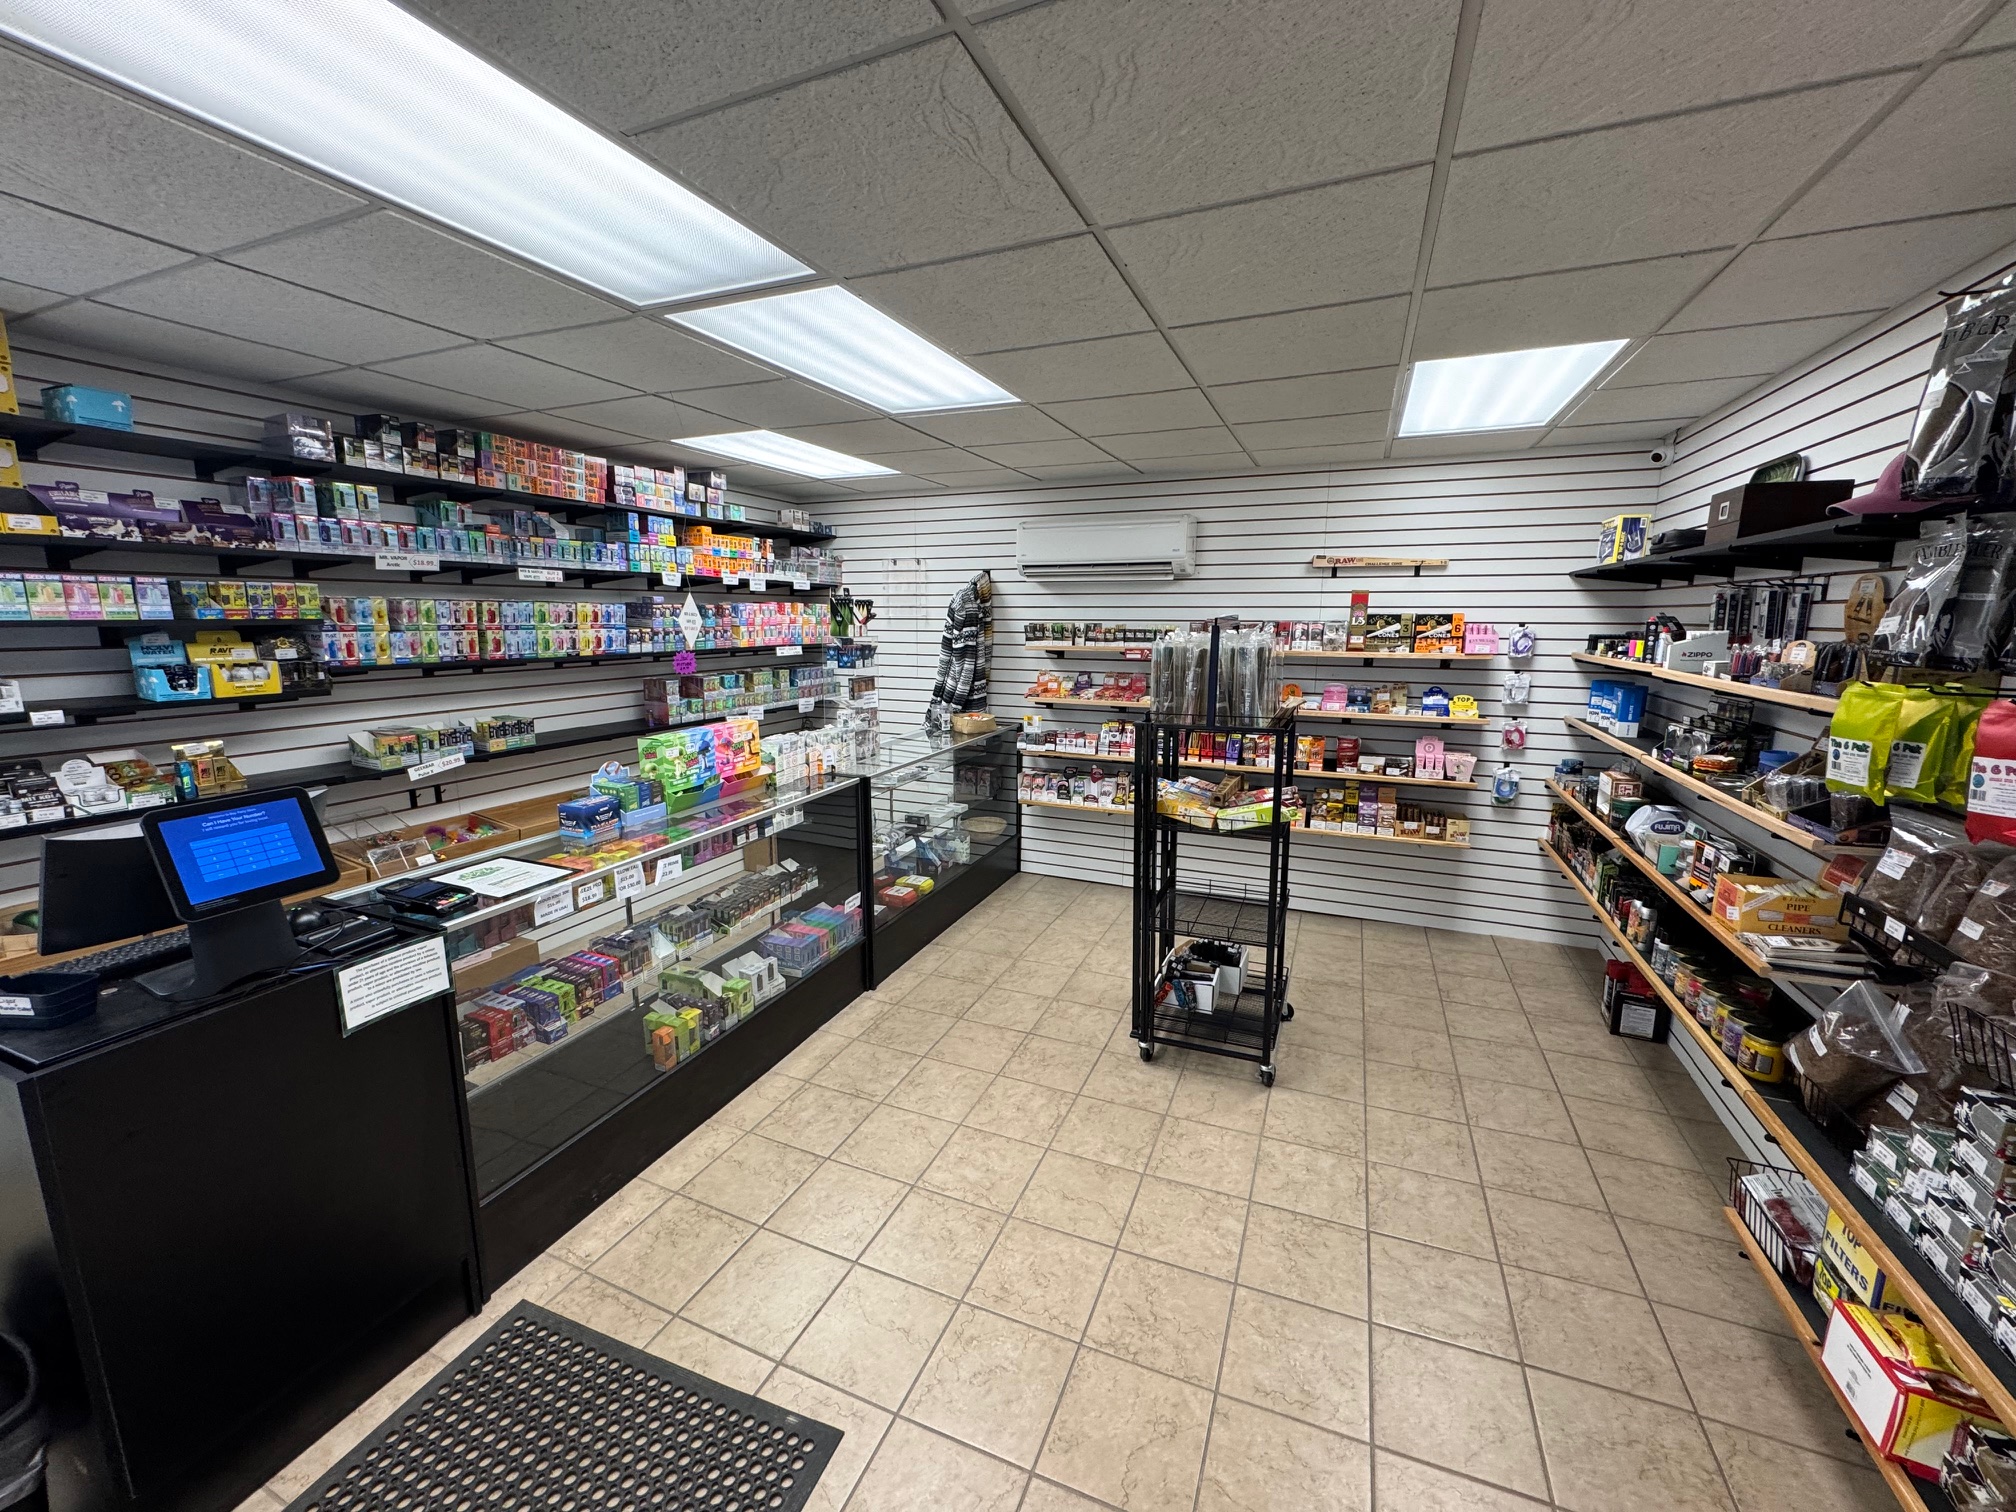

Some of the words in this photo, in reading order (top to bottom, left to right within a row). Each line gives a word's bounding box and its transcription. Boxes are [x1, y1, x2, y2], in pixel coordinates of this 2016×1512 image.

[1403, 624, 1409, 632] 3
[1831, 738, 1842, 749] The
[1892, 742, 1900, 751] 6
[1973, 762, 1987, 774] The
[1991, 765, 2002, 774] 6
[243, 810, 266, 819] Number?
[1654, 823, 1681, 832] FUJIMA
[593, 881, 602, 890] PRO
[1786, 903, 1810, 912] PIPE
[1768, 924, 1821, 934] CLEANERS
[1825, 1230, 1868, 1291] FILTERS
